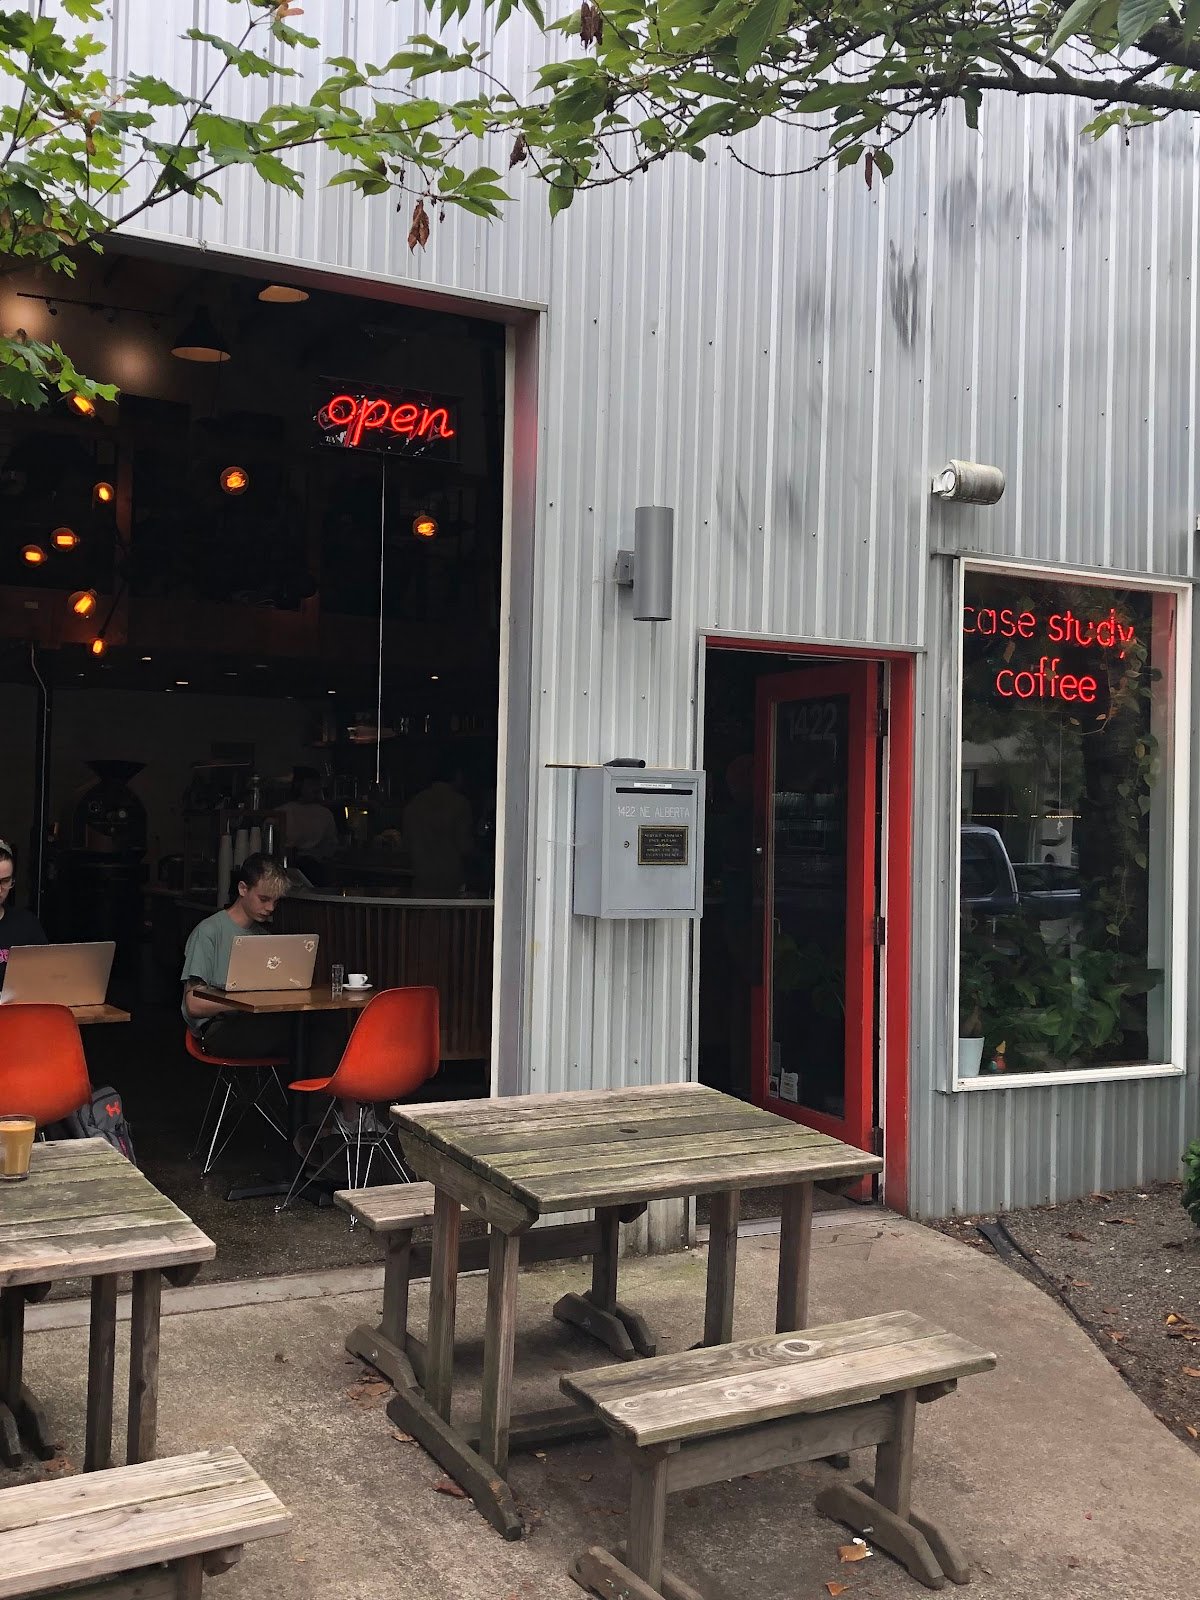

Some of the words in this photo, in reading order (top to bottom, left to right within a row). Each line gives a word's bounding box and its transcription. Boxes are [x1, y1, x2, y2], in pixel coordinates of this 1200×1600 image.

[328, 395, 454, 446] open
[963, 606, 1036, 638] case
[1048, 608, 1134, 659] study
[996, 655, 1097, 702] coffee
[784, 702, 838, 741] 1422
[617, 806, 636, 818] 1422
[639, 806, 651, 818] NE
[655, 806, 690, 818] ALBERTA
